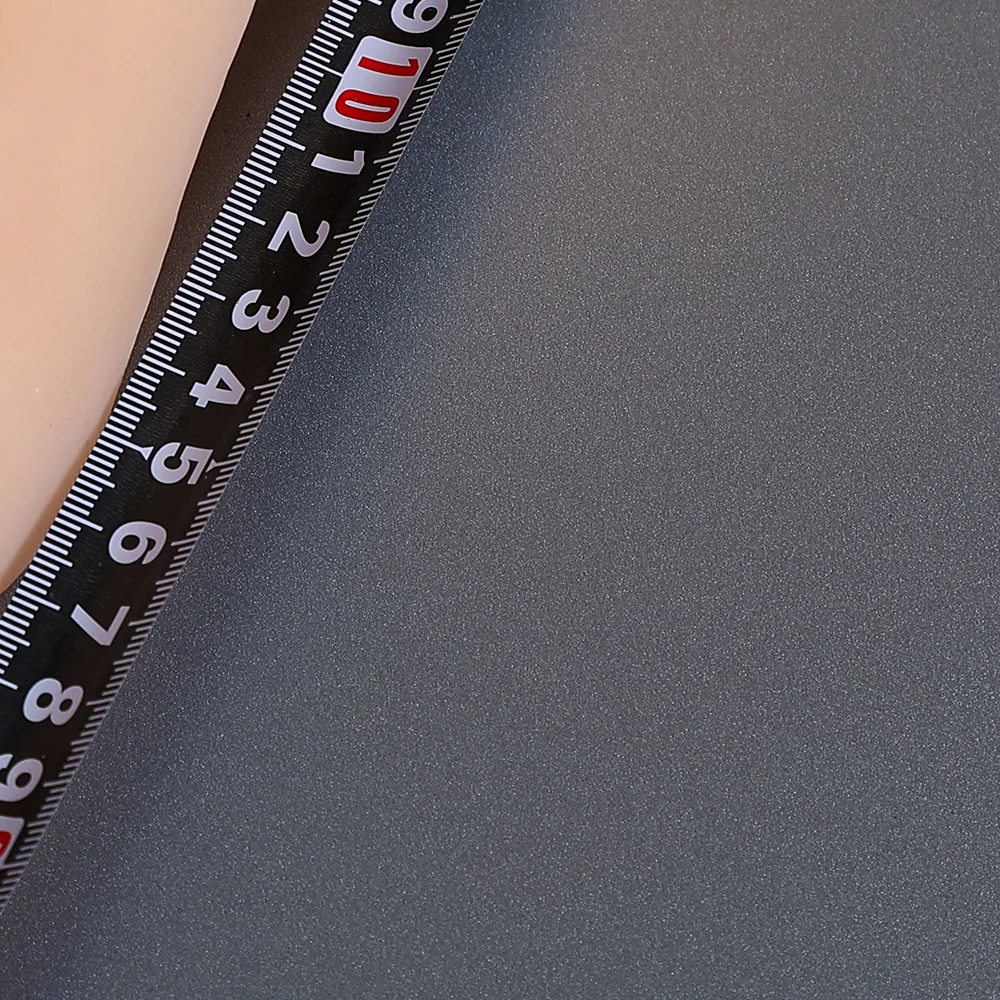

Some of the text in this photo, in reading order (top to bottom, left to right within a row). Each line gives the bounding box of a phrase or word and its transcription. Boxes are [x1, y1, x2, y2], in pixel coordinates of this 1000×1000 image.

[335, 56, 420, 122] 10
[311, 150, 365, 175] 1
[267, 211, 330, 257] 2
[231, 289, 291, 333] 3
[189, 363, 246, 408] 4
[150, 442, 213, 484] 5
[108, 521, 167, 565] 6
[71, 604, 131, 646] 7
[23, 678, 84, 726] 8
